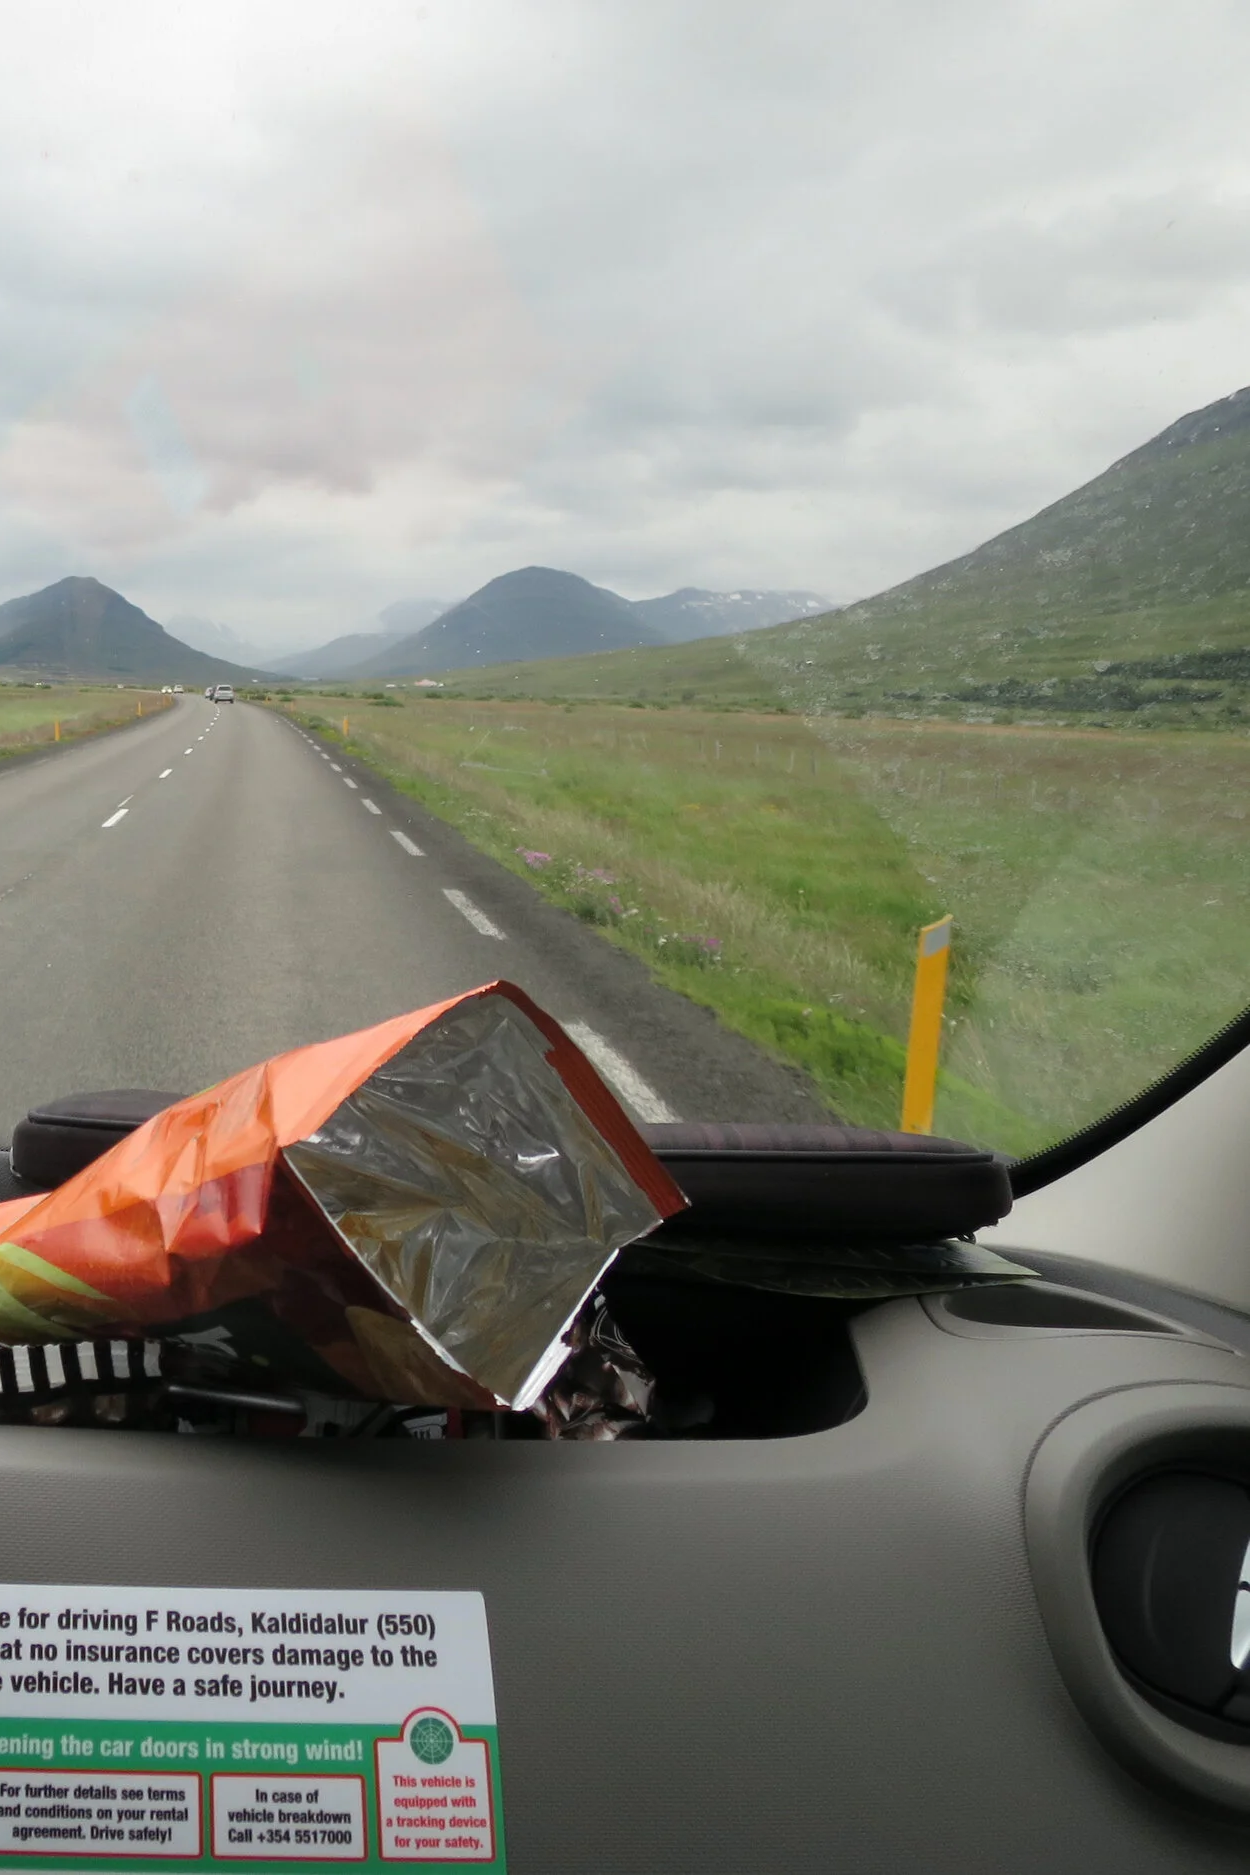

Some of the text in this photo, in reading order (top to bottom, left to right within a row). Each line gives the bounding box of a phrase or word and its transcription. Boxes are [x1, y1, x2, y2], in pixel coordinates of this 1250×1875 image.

[18, 1608, 50, 1630] for
[58, 1609, 137, 1636] driving
[146, 1611, 158, 1632] F
[167, 1612, 243, 1637] Roads,
[251, 1613, 368, 1635] Kaldidalur
[377, 1614, 436, 1640] (550)
[30, 1643, 57, 1661] no
[66, 1643, 179, 1664] insurance
[187, 1648, 264, 1665] covers
[272, 1646, 364, 1670] damage
[372, 1648, 393, 1667] to
[401, 1646, 438, 1668] the
[11, 1671, 99, 1694] vehicle.
[108, 1675, 165, 1696] Have
[173, 1680, 186, 1696] a
[194, 1676, 242, 1697] safe
[249, 1678, 345, 1702] journey.
[61, 1734, 93, 1756] the
[100, 1738, 133, 1757] car
[140, 1737, 198, 1758] doors
[206, 1739, 224, 1759] in
[232, 1740, 298, 1764] strong
[305, 1740, 363, 1761] wind!
[393, 1775, 476, 1788] This vehicle is
[0, 1784, 185, 1801] For further details see terms
[255, 1789, 319, 1804] In case of
[394, 1796, 476, 1811] equipped with
[25, 1805, 93, 1820] conditions
[97, 1809, 113, 1821] on
[117, 1809, 145, 1823] your
[150, 1808, 188, 1821] rental
[228, 1809, 351, 1824] vehicle breakdown
[386, 1816, 486, 1831] a tracking device
[13, 1826, 172, 1843] agreement. Drive safely!
[228, 1828, 352, 1844] Call +354 5517000
[394, 1835, 483, 1851] for your safety.
